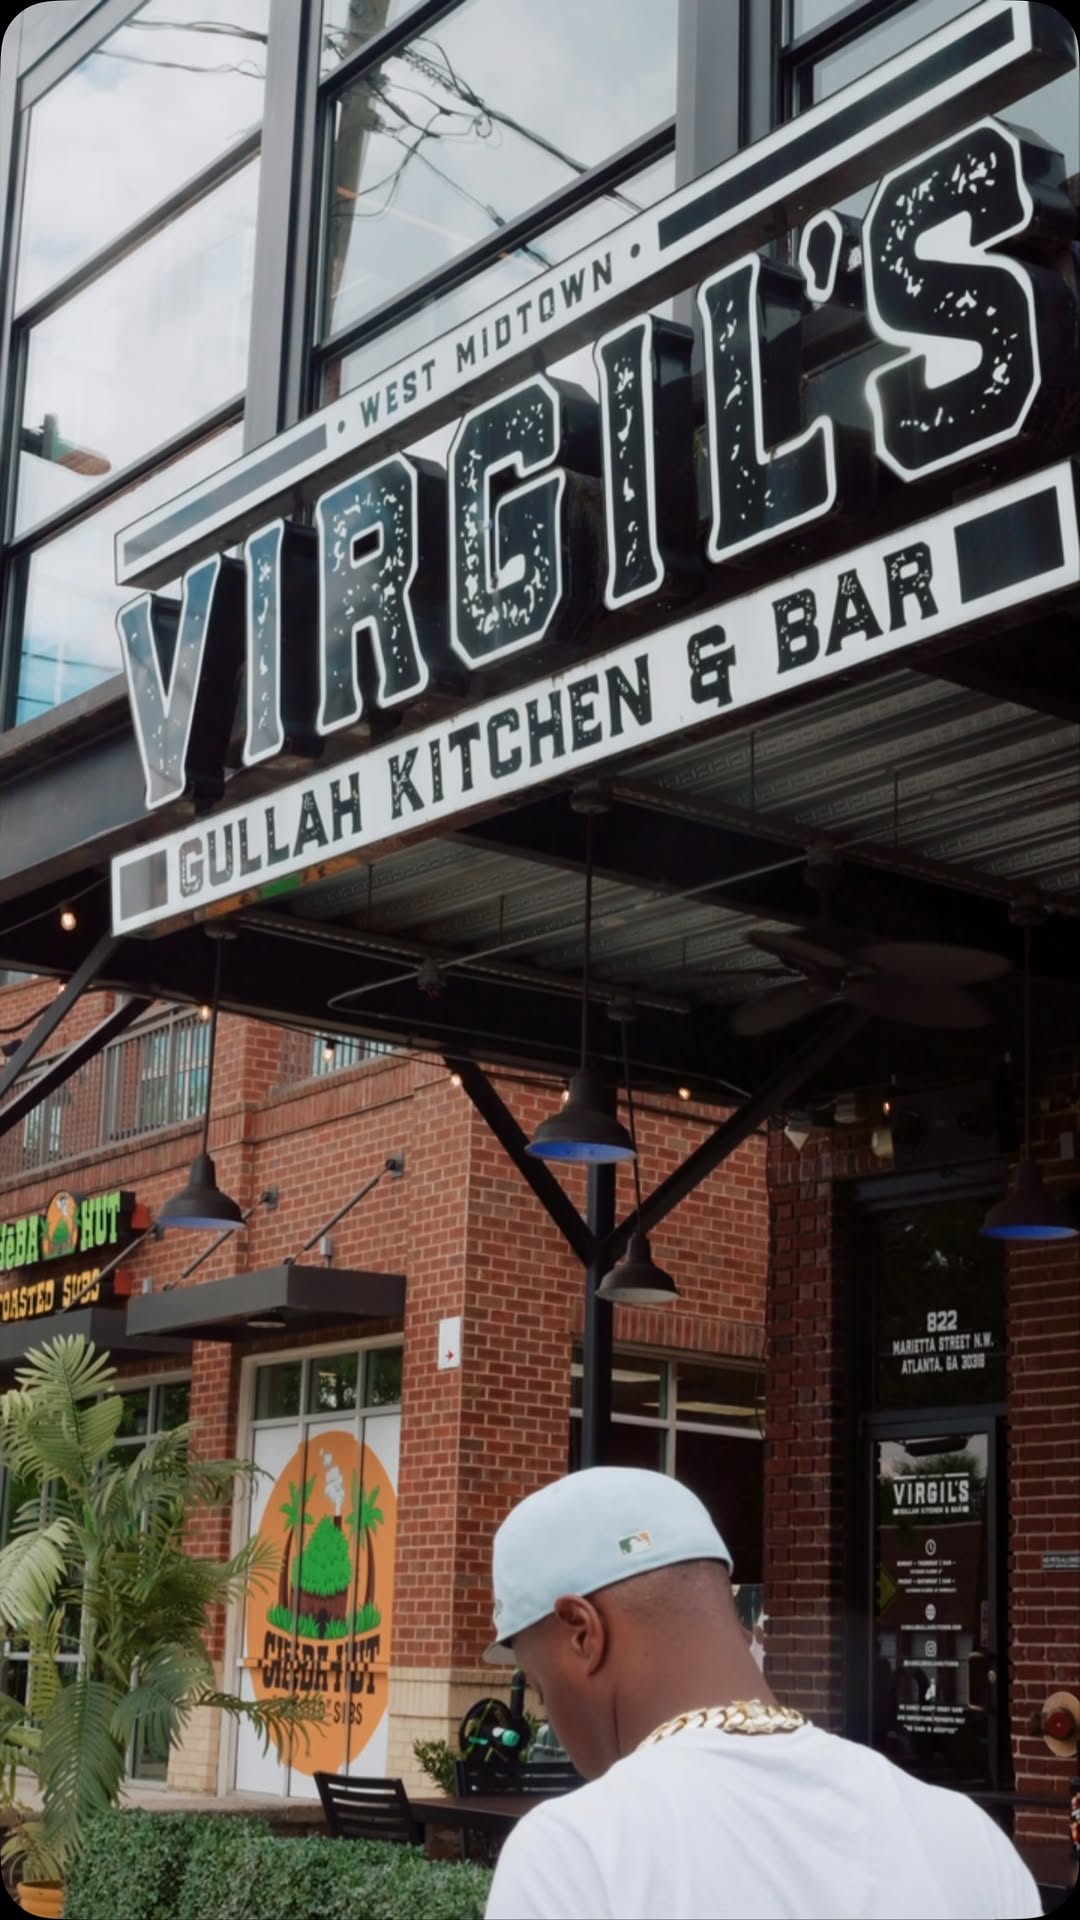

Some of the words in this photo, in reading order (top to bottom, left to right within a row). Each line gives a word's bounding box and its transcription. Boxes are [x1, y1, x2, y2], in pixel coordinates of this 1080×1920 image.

[360, 359, 436, 429] WEST
[456, 252, 613, 373] MIDTOWN
[116, 116, 1041, 811] VIRGIL'S
[178, 771, 363, 898] GULLAH
[388, 653, 653, 820] KITCHEN
[687, 624, 736, 707] &
[772, 541, 939, 674] BAR
[81, 1191, 121, 1252] HUT
[926, 1309, 958, 1333] 822
[892, 1338, 936, 1356] MARIETTA
[938, 1334, 971, 1351] STREET
[946, 1355, 959, 1371] GA
[893, 1480, 970, 1505] VIRGIL'S
